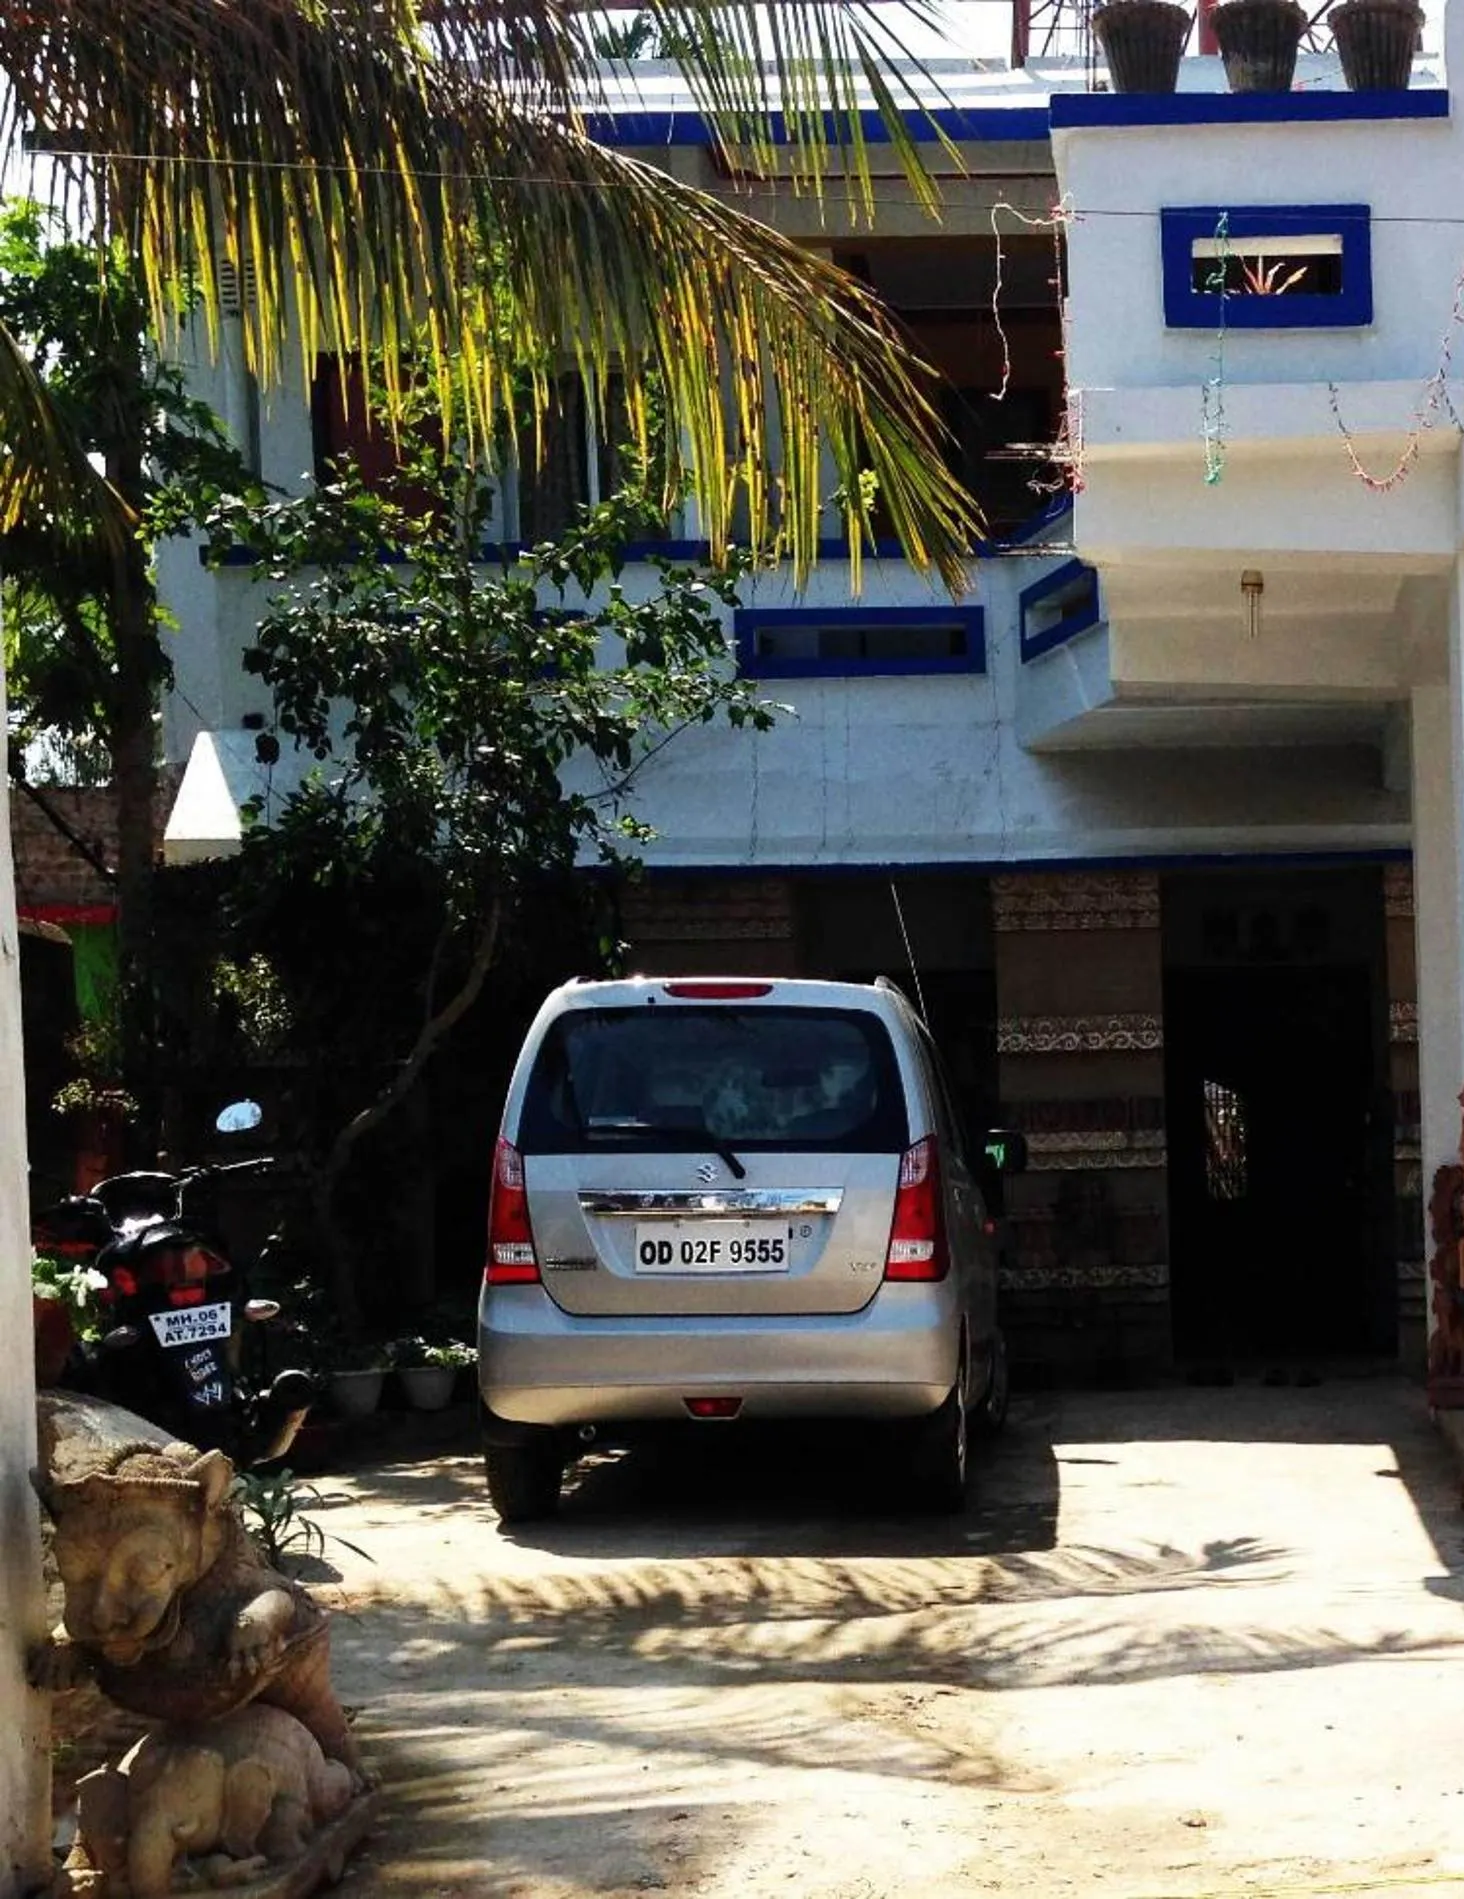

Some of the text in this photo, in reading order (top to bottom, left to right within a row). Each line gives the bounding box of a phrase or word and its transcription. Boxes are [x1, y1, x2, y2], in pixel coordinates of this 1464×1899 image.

[639, 1238, 785, 1265] OD 02F 9555
